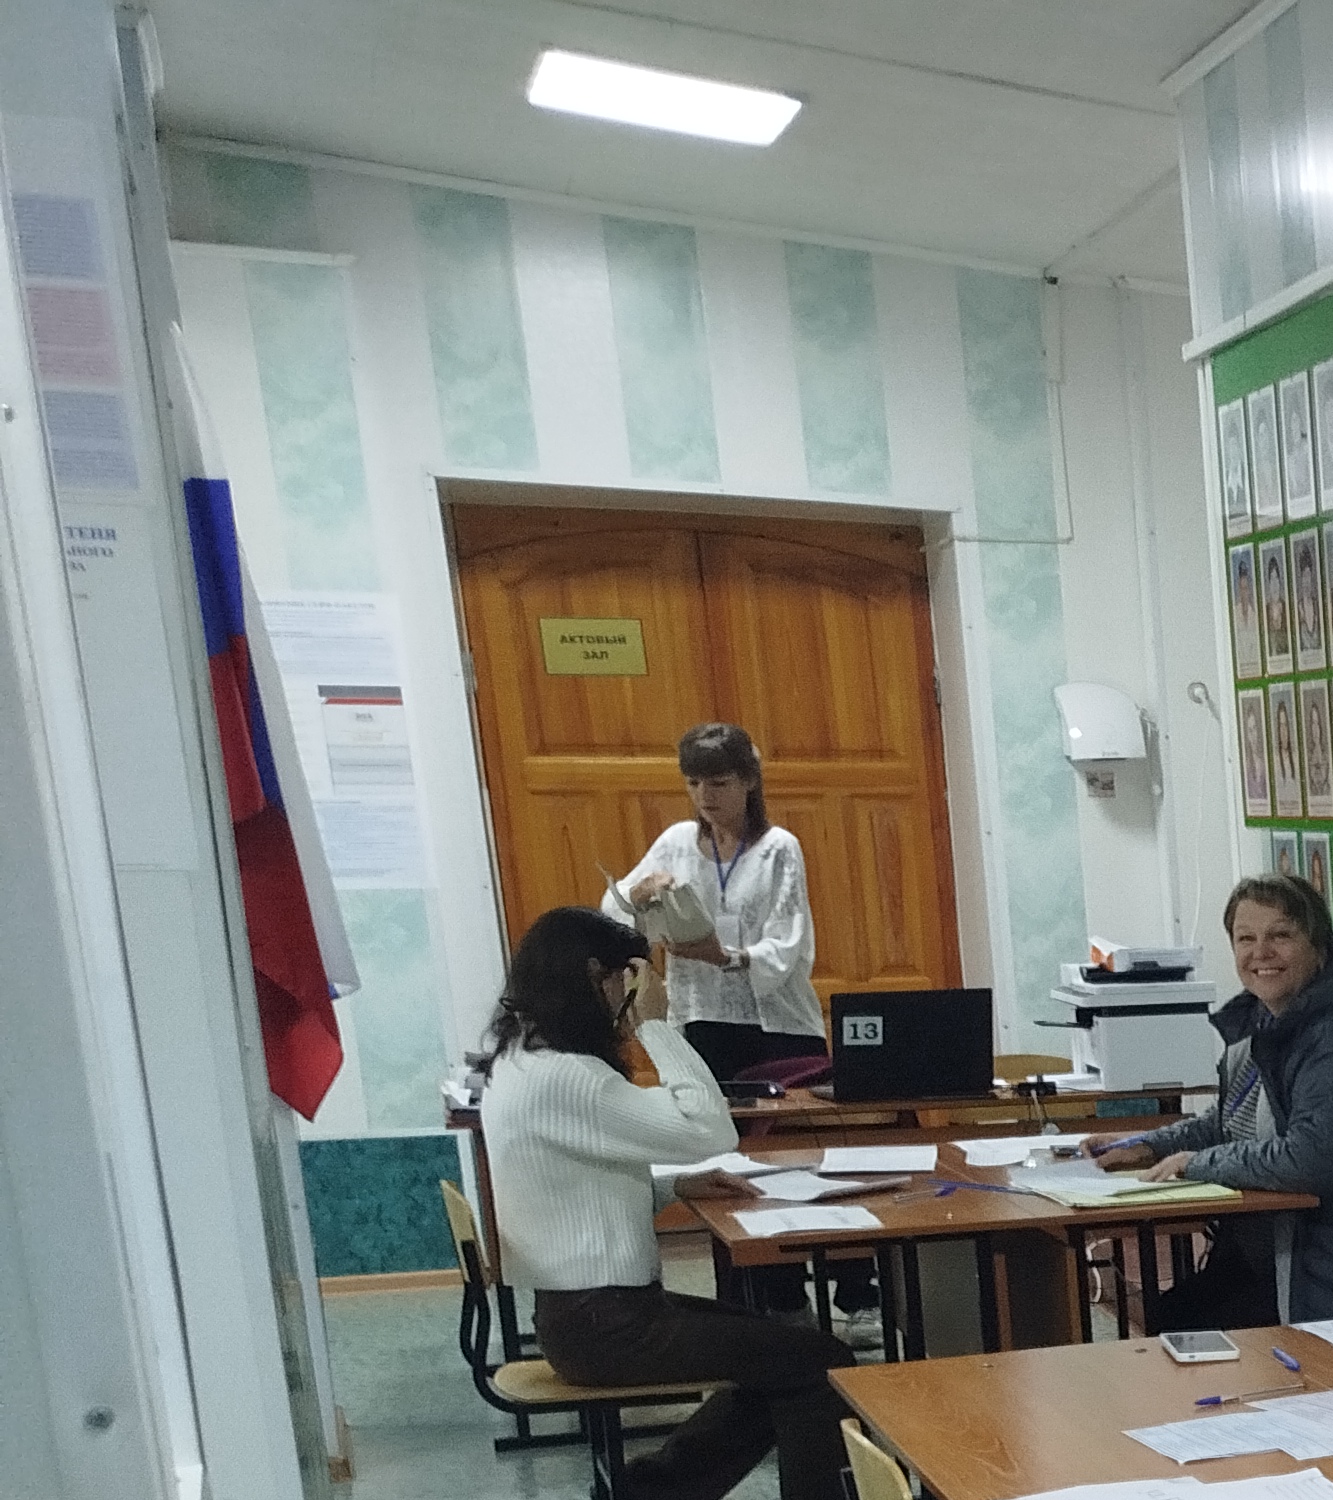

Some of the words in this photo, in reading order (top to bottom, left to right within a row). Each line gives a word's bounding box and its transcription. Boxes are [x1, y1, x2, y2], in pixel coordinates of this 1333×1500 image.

[559, 634, 627, 646] АКТОВЫЙ
[583, 650, 609, 660] ЗАЛ
[849, 1022, 879, 1040] 13
